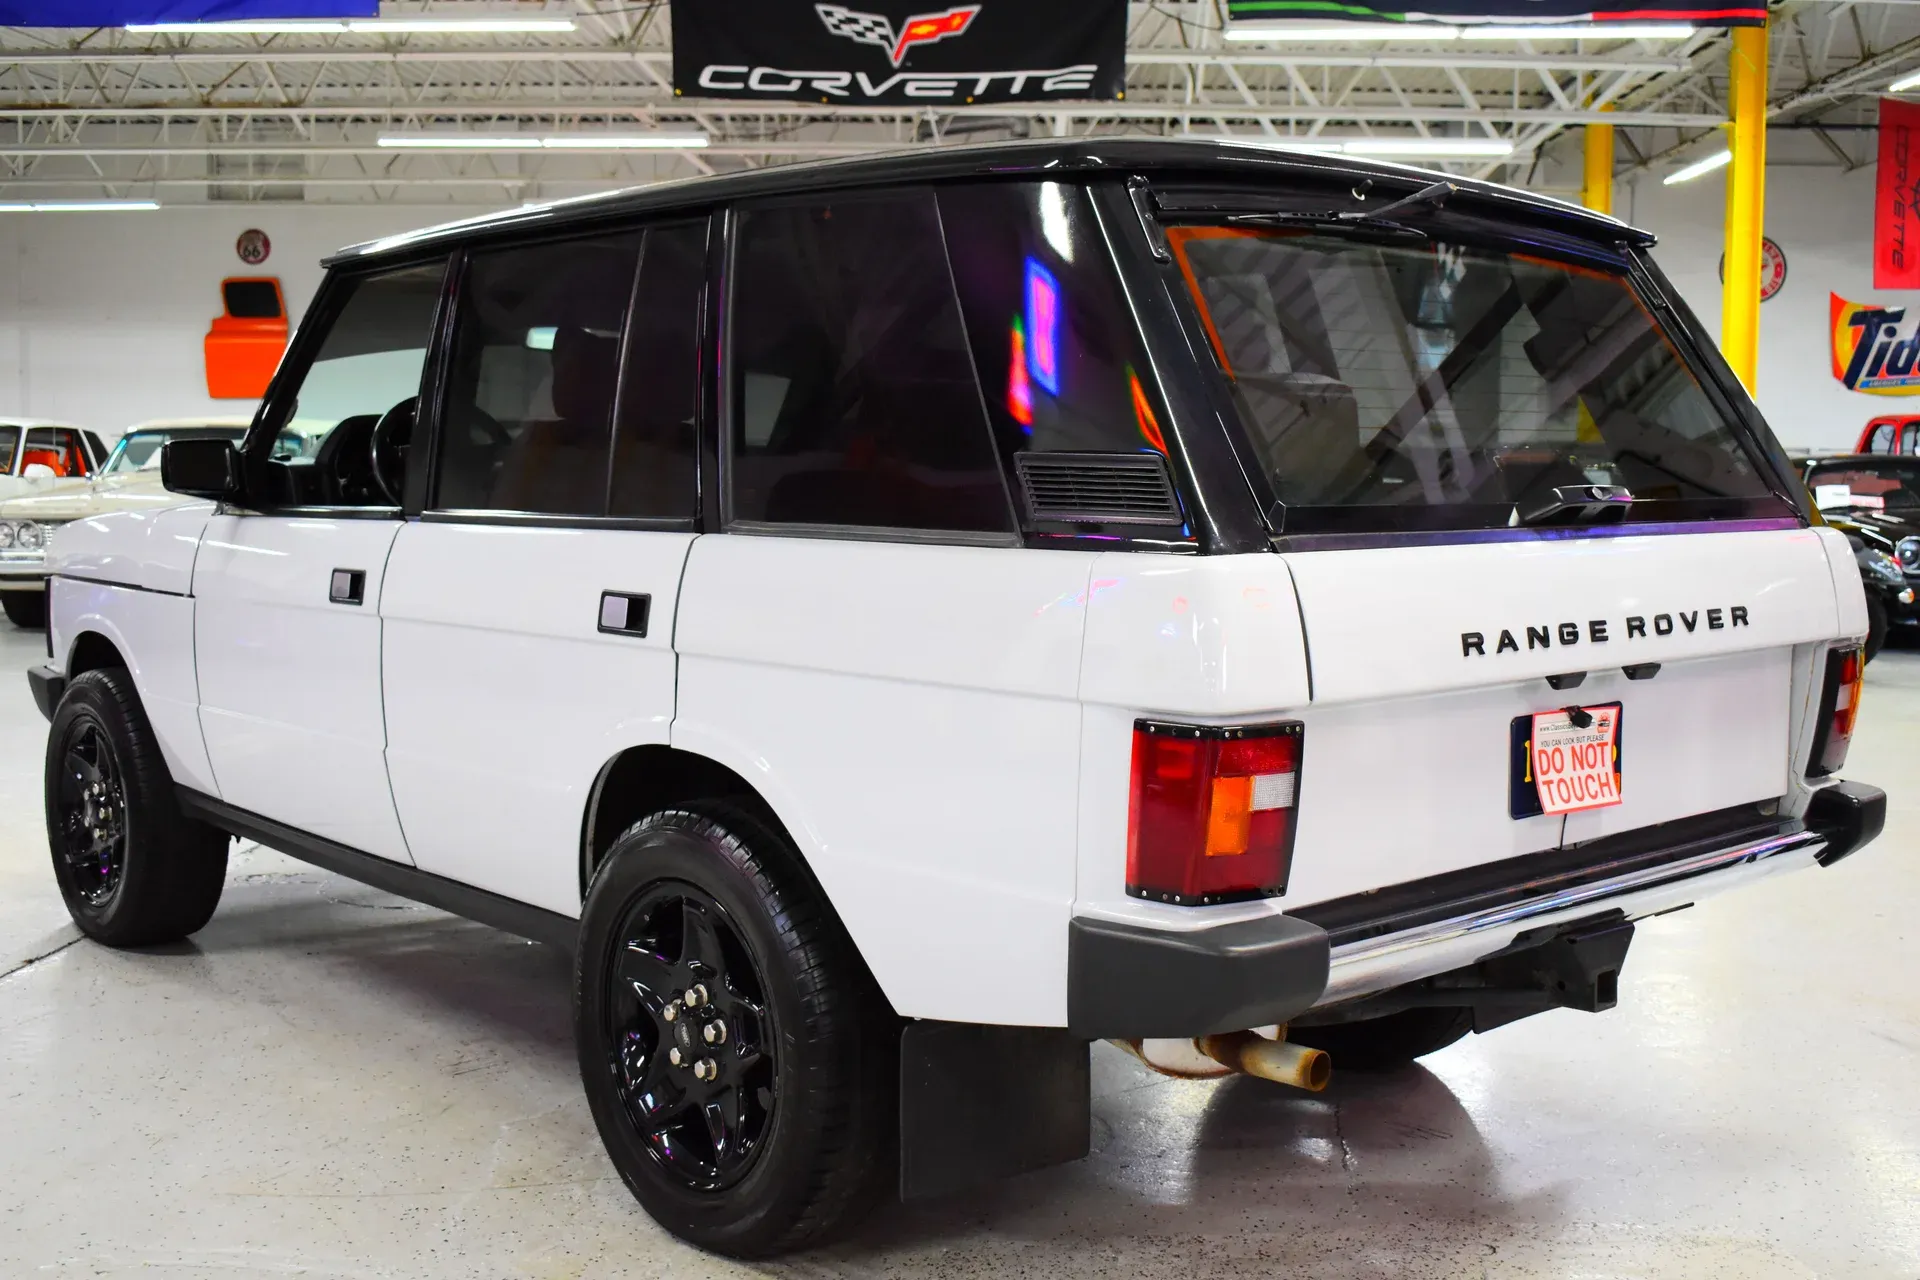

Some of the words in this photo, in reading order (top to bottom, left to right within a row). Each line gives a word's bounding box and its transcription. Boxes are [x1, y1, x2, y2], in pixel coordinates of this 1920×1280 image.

[699, 64, 1097, 95] CORVETTE
[1892, 125, 1909, 269] CORVETTE
[1843, 307, 1920, 390] Tid
[1461, 620, 1609, 656] RANGE
[1626, 605, 1749, 638] ROVER
[1540, 740, 1550, 748] YOU
[1551, 739, 1561, 747] CAN
[1563, 737, 1575, 745] LOOK
[1576, 735, 1586, 743] BUT
[1587, 734, 1604, 742] PLEASE
[1538, 747, 1564, 775] DO
[1571, 742, 1608, 771] NOT
[1542, 772, 1613, 806] TOUCH
